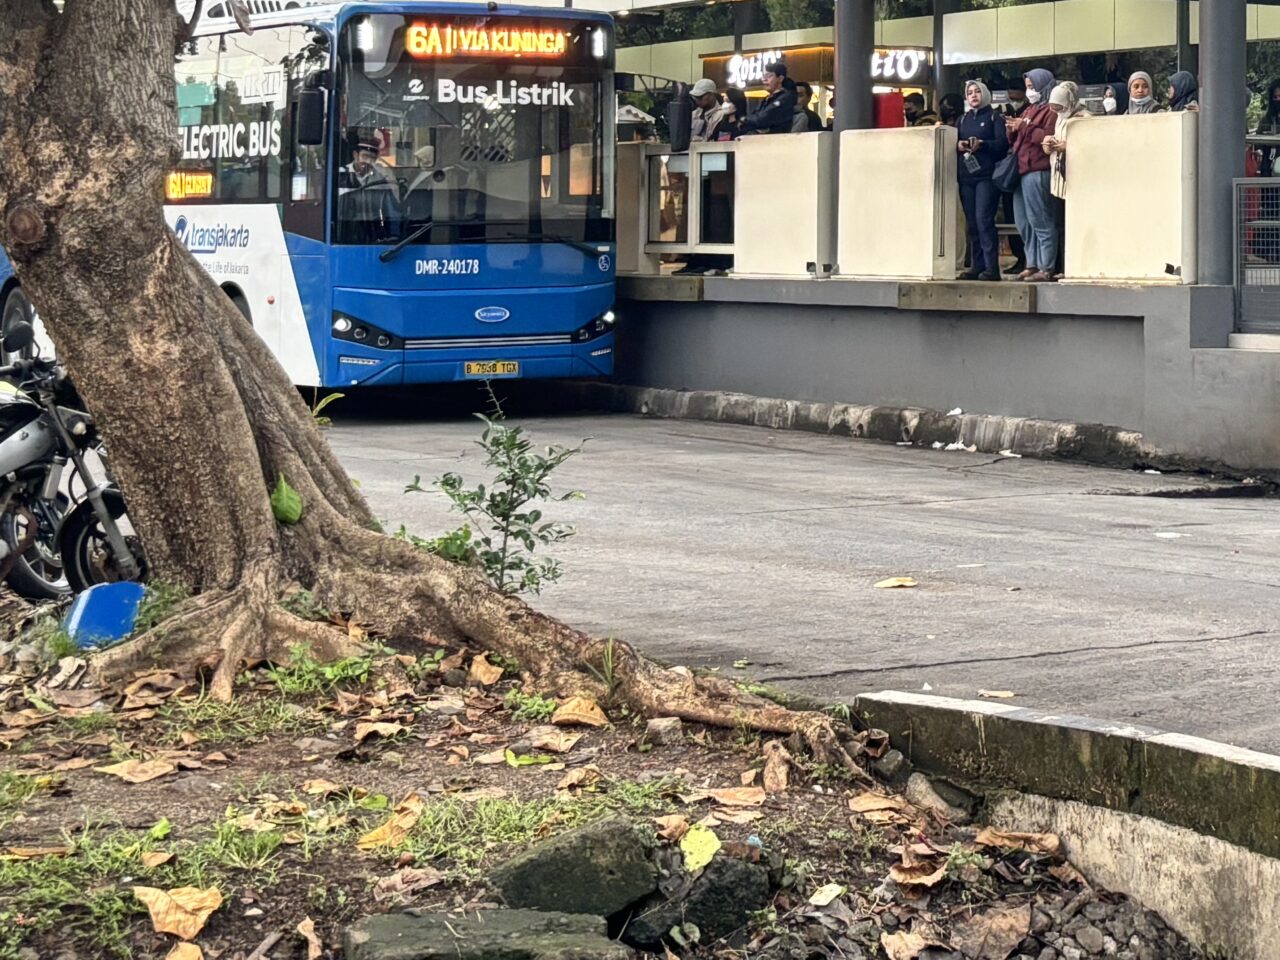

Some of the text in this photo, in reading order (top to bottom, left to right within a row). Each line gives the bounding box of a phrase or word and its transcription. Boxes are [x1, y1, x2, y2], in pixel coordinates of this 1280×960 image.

[409, 26, 442, 54] 6A
[459, 28, 490, 52] VIA
[437, 78, 574, 106] Bus Listrik
[249, 119, 281, 157] BUS
[190, 223, 250, 254] transjakarta
[415, 259, 479, 275] DMR-240178
[466, 363, 472, 374] B
[501, 362, 517, 373] TGX
